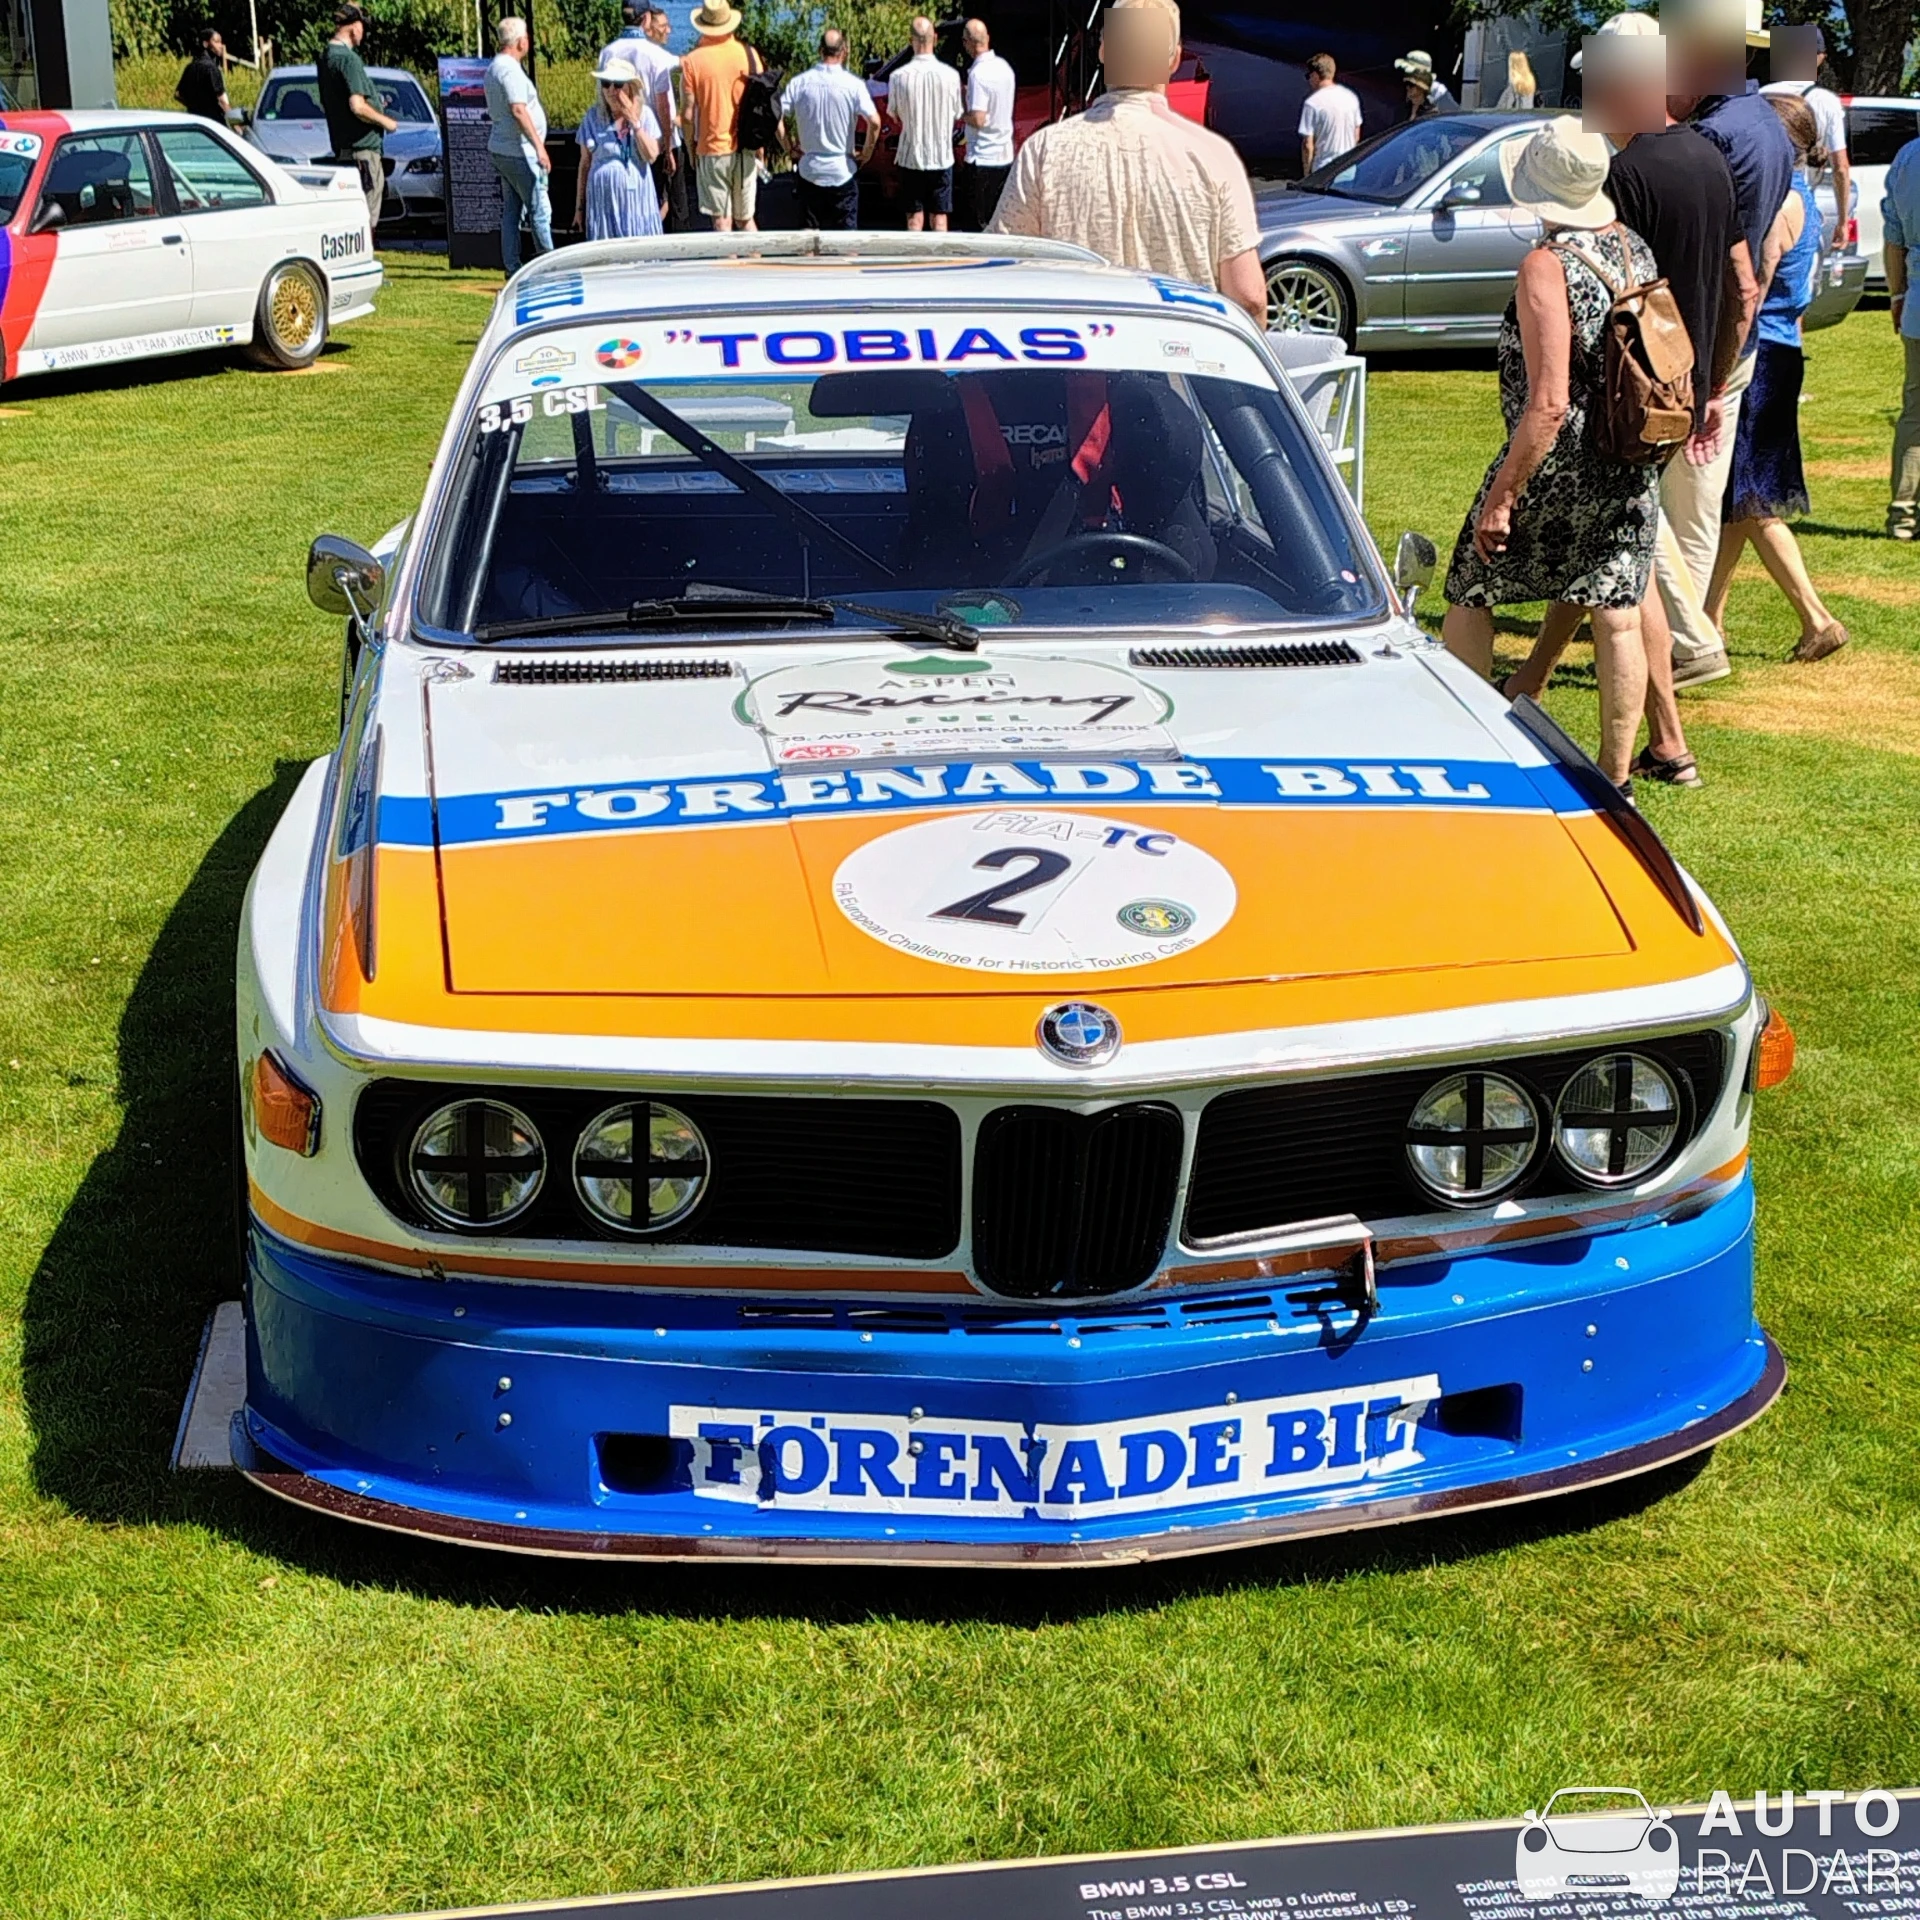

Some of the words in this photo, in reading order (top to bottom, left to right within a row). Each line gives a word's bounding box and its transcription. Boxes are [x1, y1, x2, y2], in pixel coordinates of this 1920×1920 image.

[321, 226, 365, 261] Castrol
[59, 349, 89, 364] BMW
[169, 329, 215, 347] SWEDEN
[479, 396, 533, 434] 3,5
[543, 384, 607, 417] CSL
[1000, 424, 1069, 444] RECA
[878, 677, 1016, 690] ASPEN
[775, 690, 1136, 725] Racing
[905, 714, 1029, 724] FUEL
[1261, 764, 1491, 799] BIL
[927, 846, 1072, 929] 2
[840, 897, 888, 936] European
[888, 933, 972, 965] Challenge
[977, 956, 1004, 968] for
[1008, 958, 1084, 970] Historic
[1085, 950, 1156, 969] Touring
[1157, 936, 1196, 954] Cars
[698, 1415, 1242, 1504] FÖRENADE
[1265, 1396, 1406, 1478] BIL
[1079, 1881, 1146, 1900] BMW
[1149, 1876, 1191, 1894] 3.5
[1195, 1872, 1247, 1890] CSL
[1455, 1879, 1520, 1895] spoilers
[1087, 1909, 1122, 1920] The
[1125, 1904, 1172, 1919] BMW
[1175, 1901, 1204, 1915] 3.5
[1207, 1899, 1245, 1913] CSL
[1246, 1897, 1283, 1909] was
[1286, 1896, 1298, 1906] a
[1301, 1891, 1357, 1905] further
[1293, 1901, 1382, 1919] successful
[1384, 1900, 1417, 1913] E9-
[1469, 1906, 1535, 1920] stability
[1539, 1902, 1573, 1916] and
[1575, 1901, 1609, 1915] grip
[1611, 1900, 1630, 1911] at
[1630, 1897, 1670, 1912] high
[1672, 1891, 1739, 1907] speeds.
[1658, 1910, 1682, 1920] on
[1683, 1908, 1713, 1920] the
[1713, 1901, 1810, 1920] lightweight
[1843, 1901, 1880, 1913] The
[1880, 1898, 1920, 1911] BM
